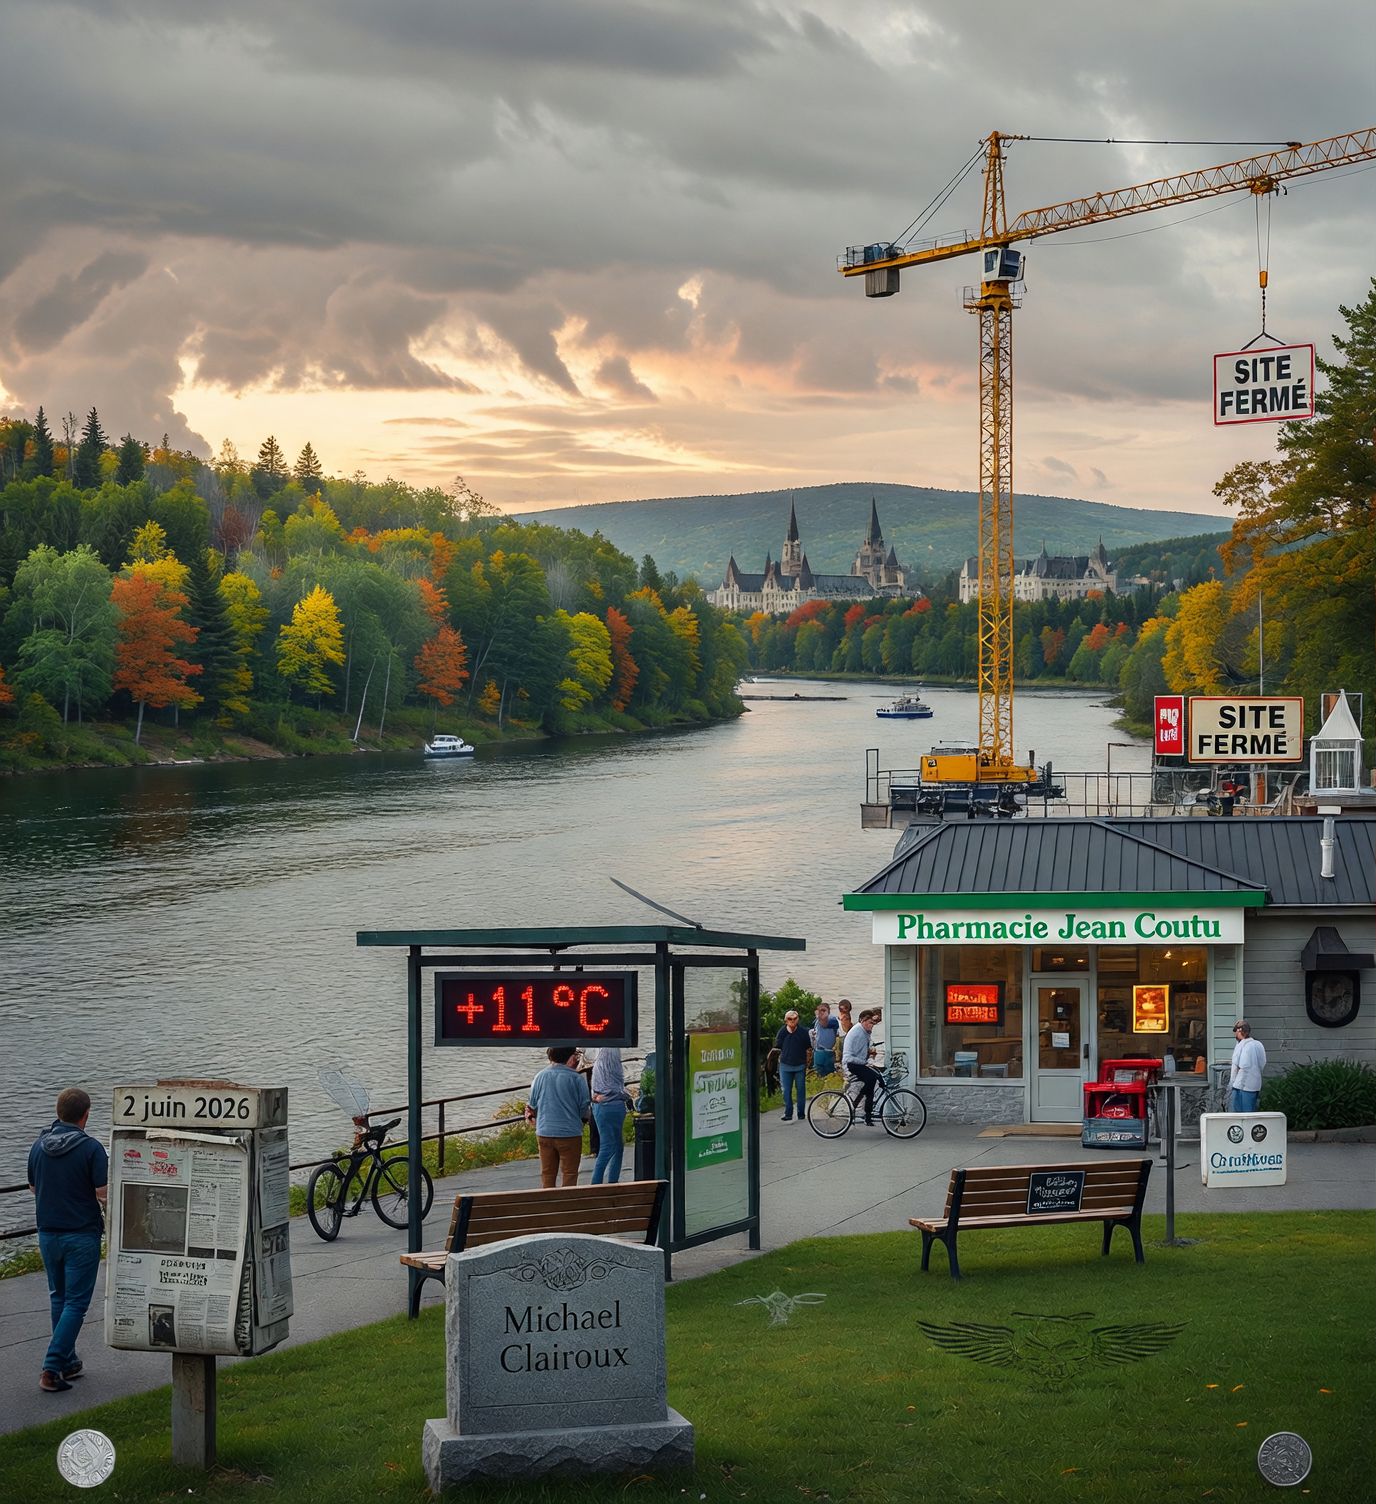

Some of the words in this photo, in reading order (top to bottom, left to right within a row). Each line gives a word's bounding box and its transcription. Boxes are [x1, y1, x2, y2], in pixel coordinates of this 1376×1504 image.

[1234, 355, 1292, 384] SITE
[1220, 378, 1308, 416] FERMÉ
[1218, 705, 1286, 729] SITE
[1198, 731, 1288, 755] FERMÉ
[897, 914, 1049, 940] Pharmacie
[1058, 914, 1127, 939] Jean
[1134, 912, 1222, 939] Coutu
[457, 985, 609, 1032] +11°C
[123, 1095, 136, 1117] 2
[141, 1095, 186, 1122] juin
[194, 1097, 251, 1119] 2026
[503, 1300, 623, 1335] Michael
[500, 1343, 631, 1374] Clairoux
